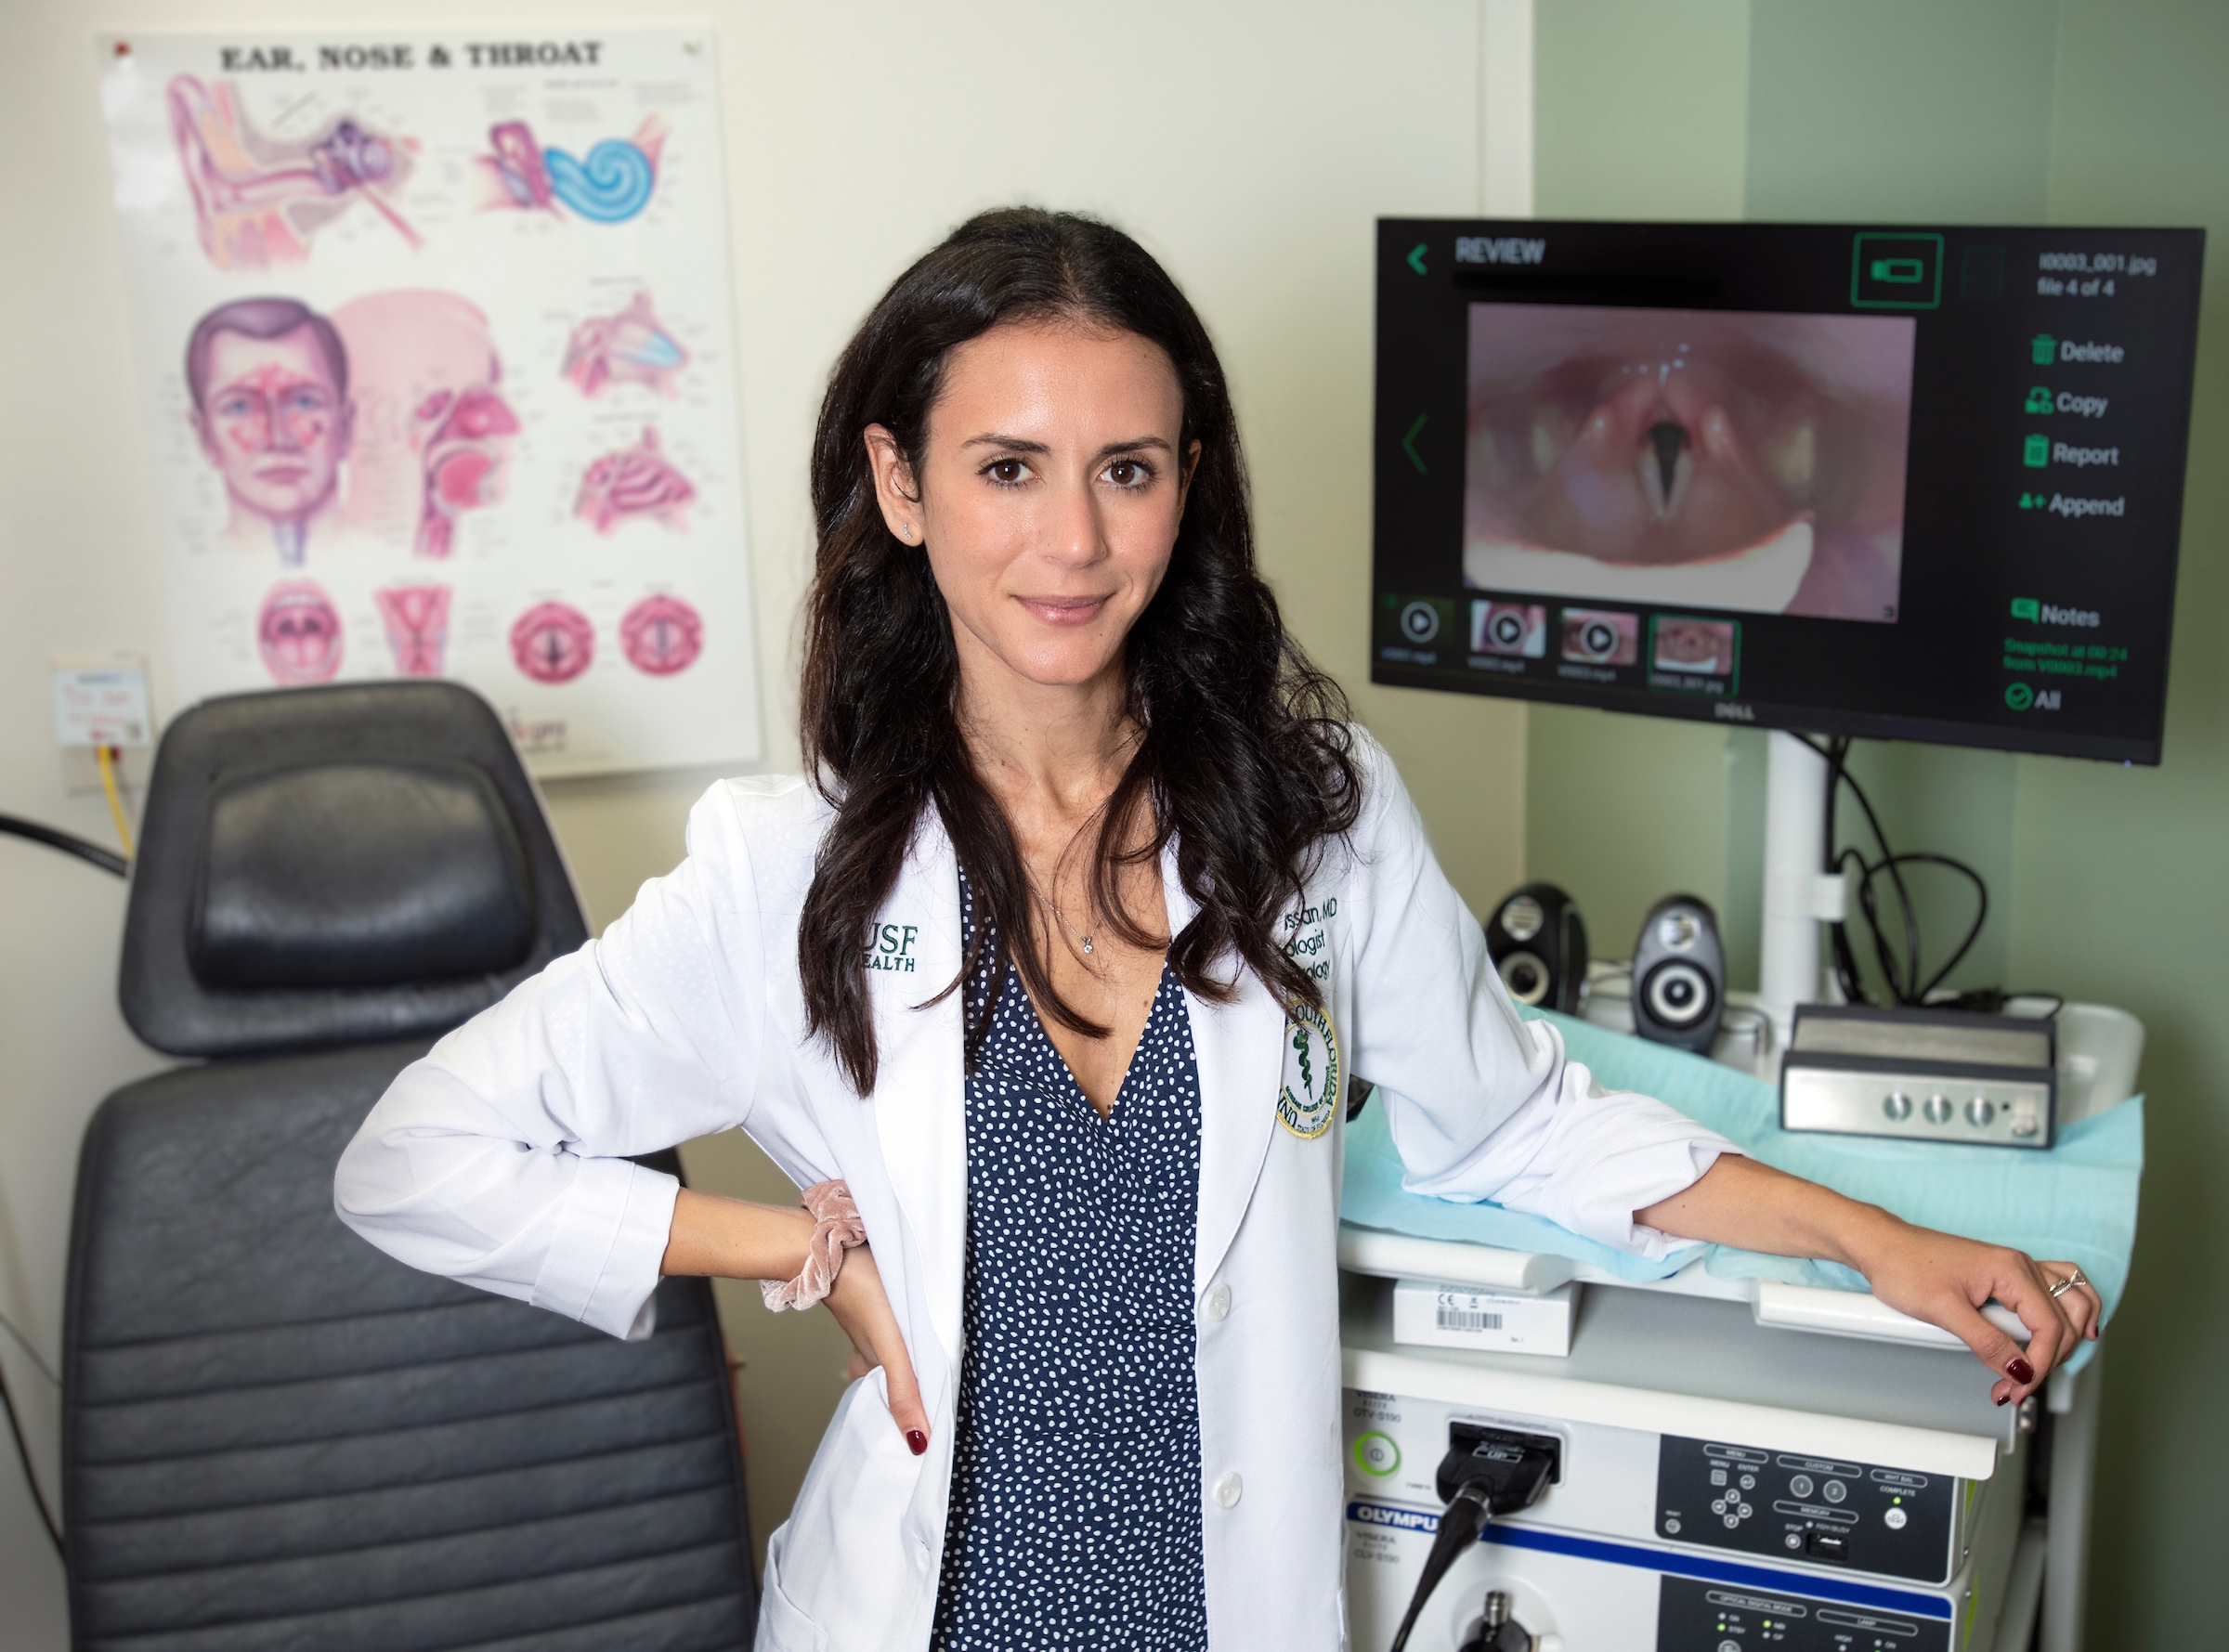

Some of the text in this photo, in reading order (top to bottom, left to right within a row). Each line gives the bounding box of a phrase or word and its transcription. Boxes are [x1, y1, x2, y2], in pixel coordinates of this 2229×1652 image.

[219, 41, 603, 73] EAR, NOSE & THROAT
[1455, 236, 1546, 265] REVIEW
[2037, 276, 2115, 297] file 4 of 4
[2060, 340, 2125, 363] Delete
[2056, 391, 2109, 418] Copy
[2053, 442, 2120, 468] Report
[2048, 492, 2125, 518] Append
[2041, 604, 2100, 628] Notes
[2034, 689, 2062, 710] All
[1714, 702, 1756, 721] DELL
[1323, 897, 1337, 920] MD
[1354, 1407, 1401, 1424] OTV-S190
[1726, 1450, 1746, 1458] MENU
[1710, 1459, 1760, 1473] MENU ENTER
[1805, 1461, 1834, 1472] CUSTOM
[1879, 1485, 1917, 1498] COMPLETE
[1357, 1505, 1439, 1532] OLYMPU
[1800, 1505, 1831, 1517] MEMORY
[1784, 1523, 1805, 1533] STOP
